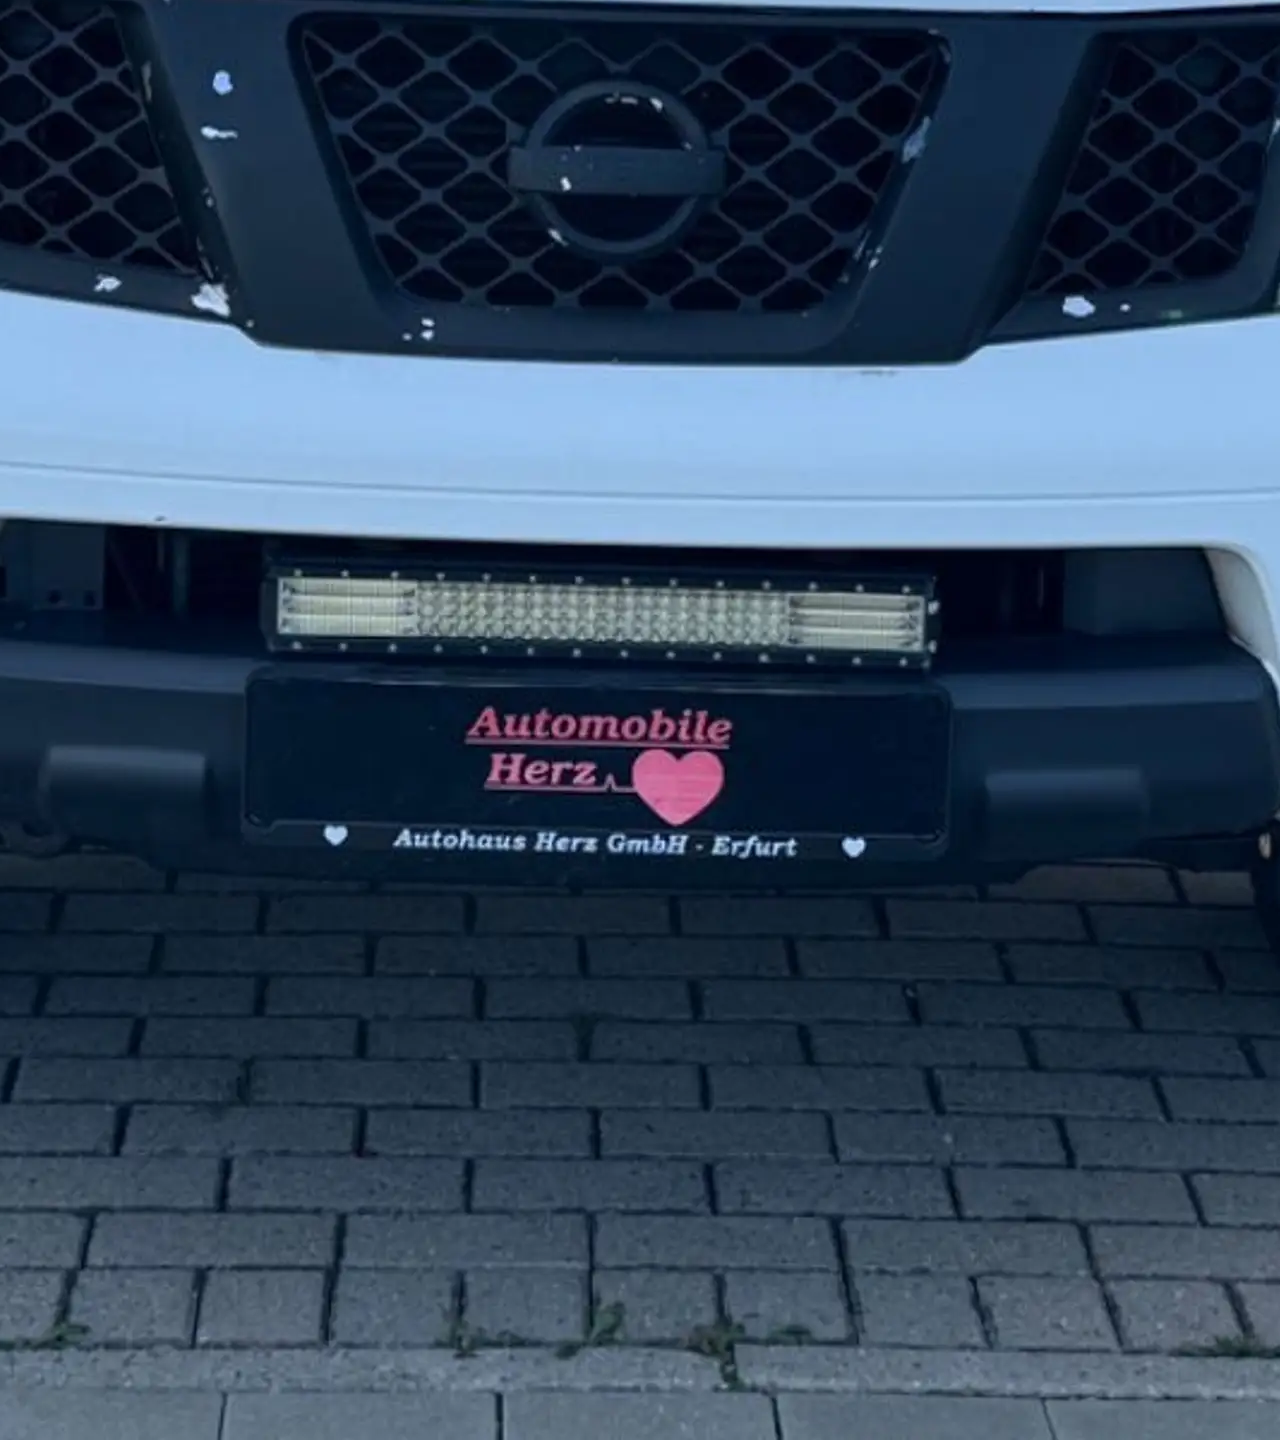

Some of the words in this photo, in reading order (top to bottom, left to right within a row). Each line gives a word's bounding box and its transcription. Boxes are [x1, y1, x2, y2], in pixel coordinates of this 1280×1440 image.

[468, 706, 733, 742] Automobile
[486, 752, 598, 786] Herz
[392, 828, 527, 851] Autohaus
[534, 831, 598, 853] Herz
[606, 832, 689, 856] GmbH
[711, 834, 799, 860] Erfurt
